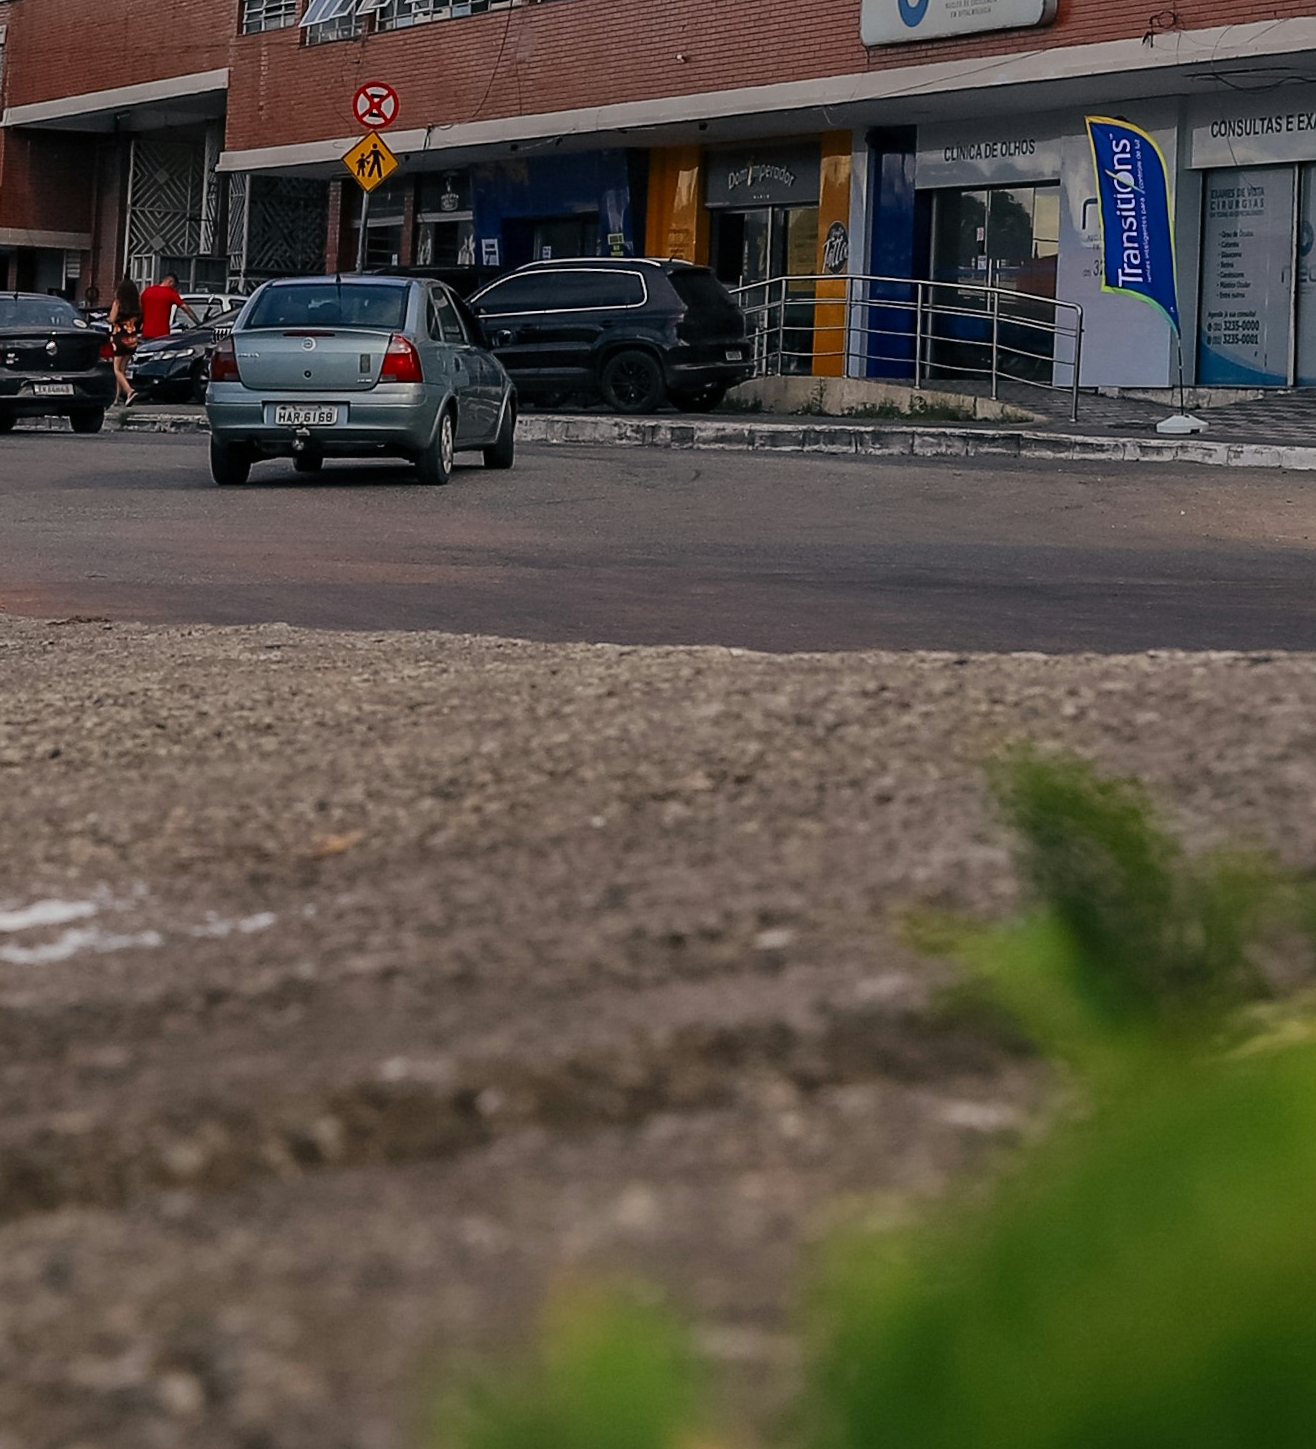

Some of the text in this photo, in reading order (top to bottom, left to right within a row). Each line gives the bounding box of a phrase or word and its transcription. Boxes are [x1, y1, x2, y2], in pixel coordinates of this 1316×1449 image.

[1210, 115, 1283, 138] CONSULTAS
[1286, 114, 1295, 132] E
[944, 139, 1036, 162] CLÍNICA DE OLHOS
[1111, 138, 1143, 288] Transitions
[1210, 198, 1264, 211] CIRURGIAS
[1223, 320, 1260, 331] 3235-0000
[1223, 333, 1259, 345] 3235-0001
